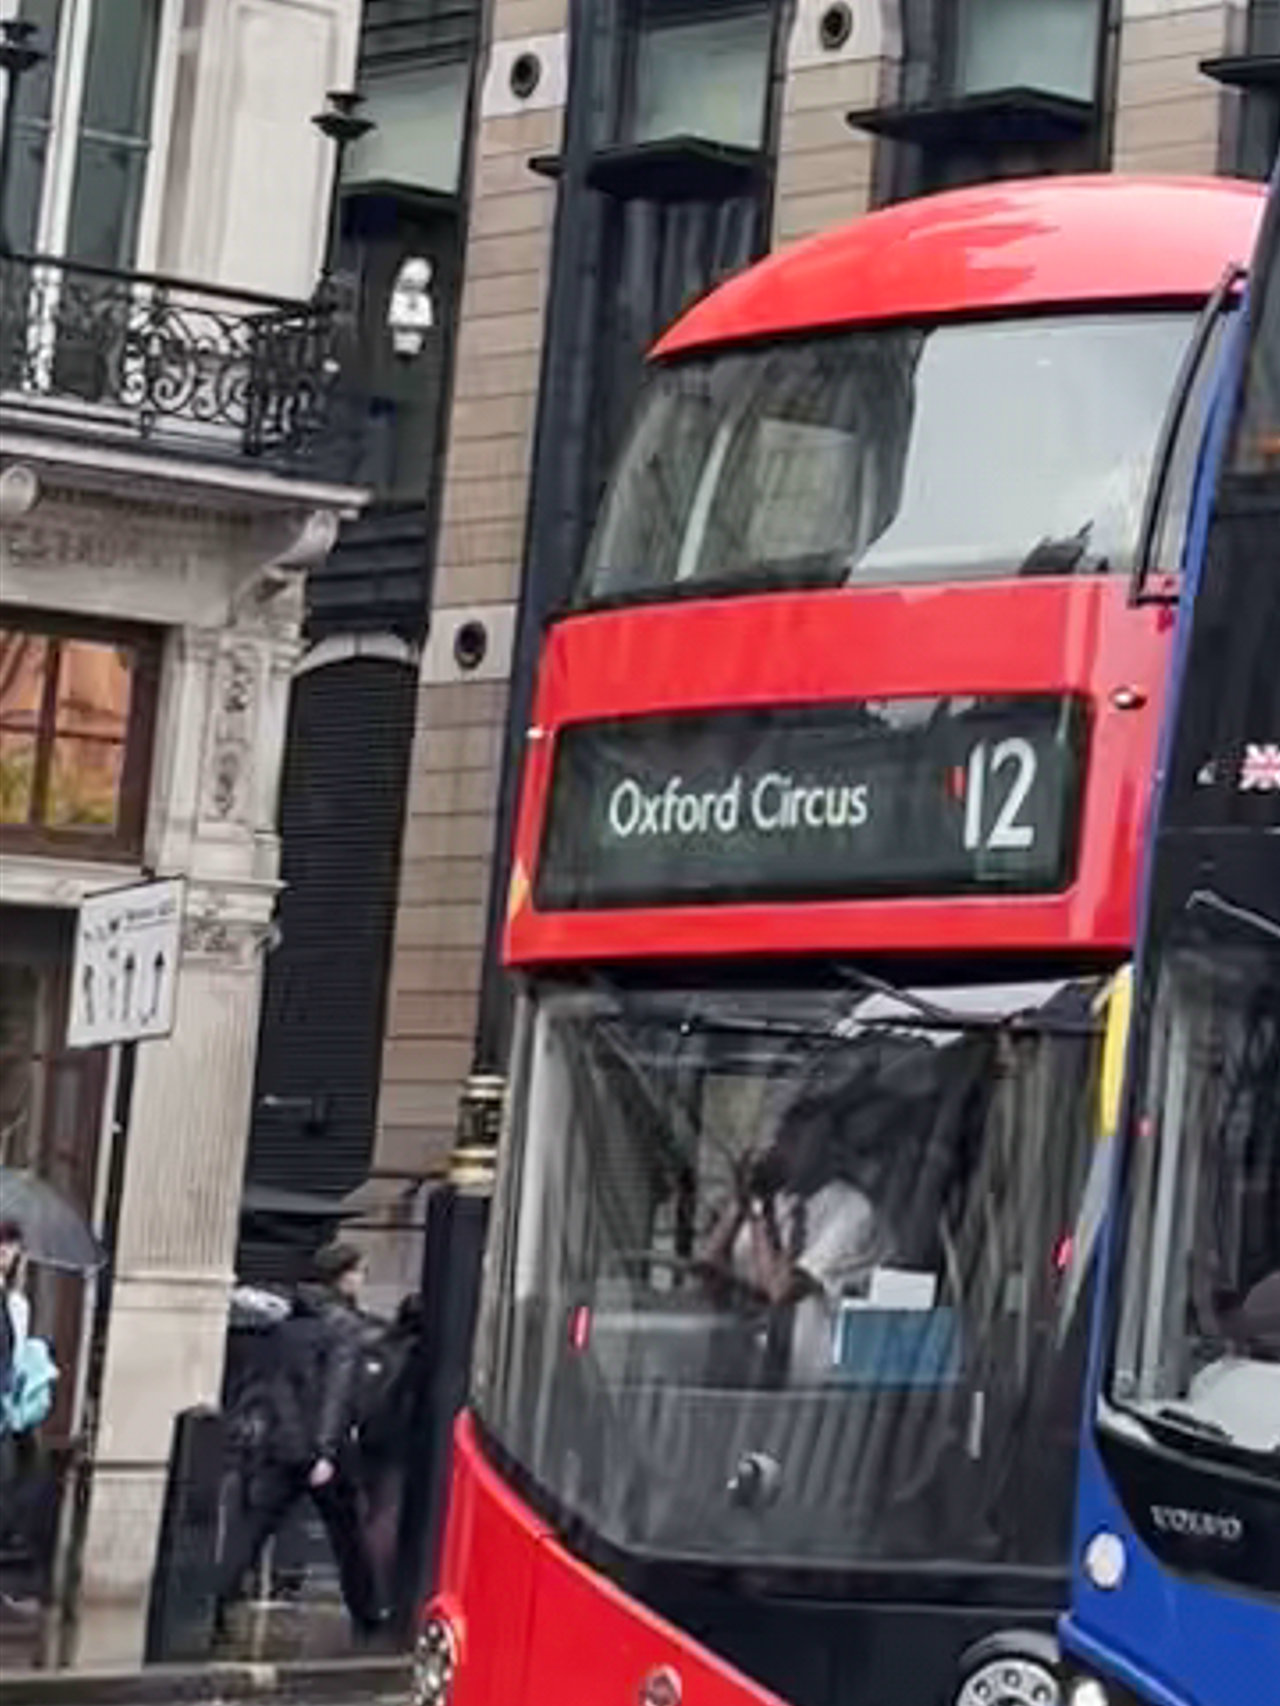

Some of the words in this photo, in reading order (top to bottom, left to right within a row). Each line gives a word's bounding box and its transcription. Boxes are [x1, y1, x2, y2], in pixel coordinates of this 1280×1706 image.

[608, 773, 739, 837] Oxford
[752, 772, 868, 831] Circus
[964, 736, 1038, 850] 12
